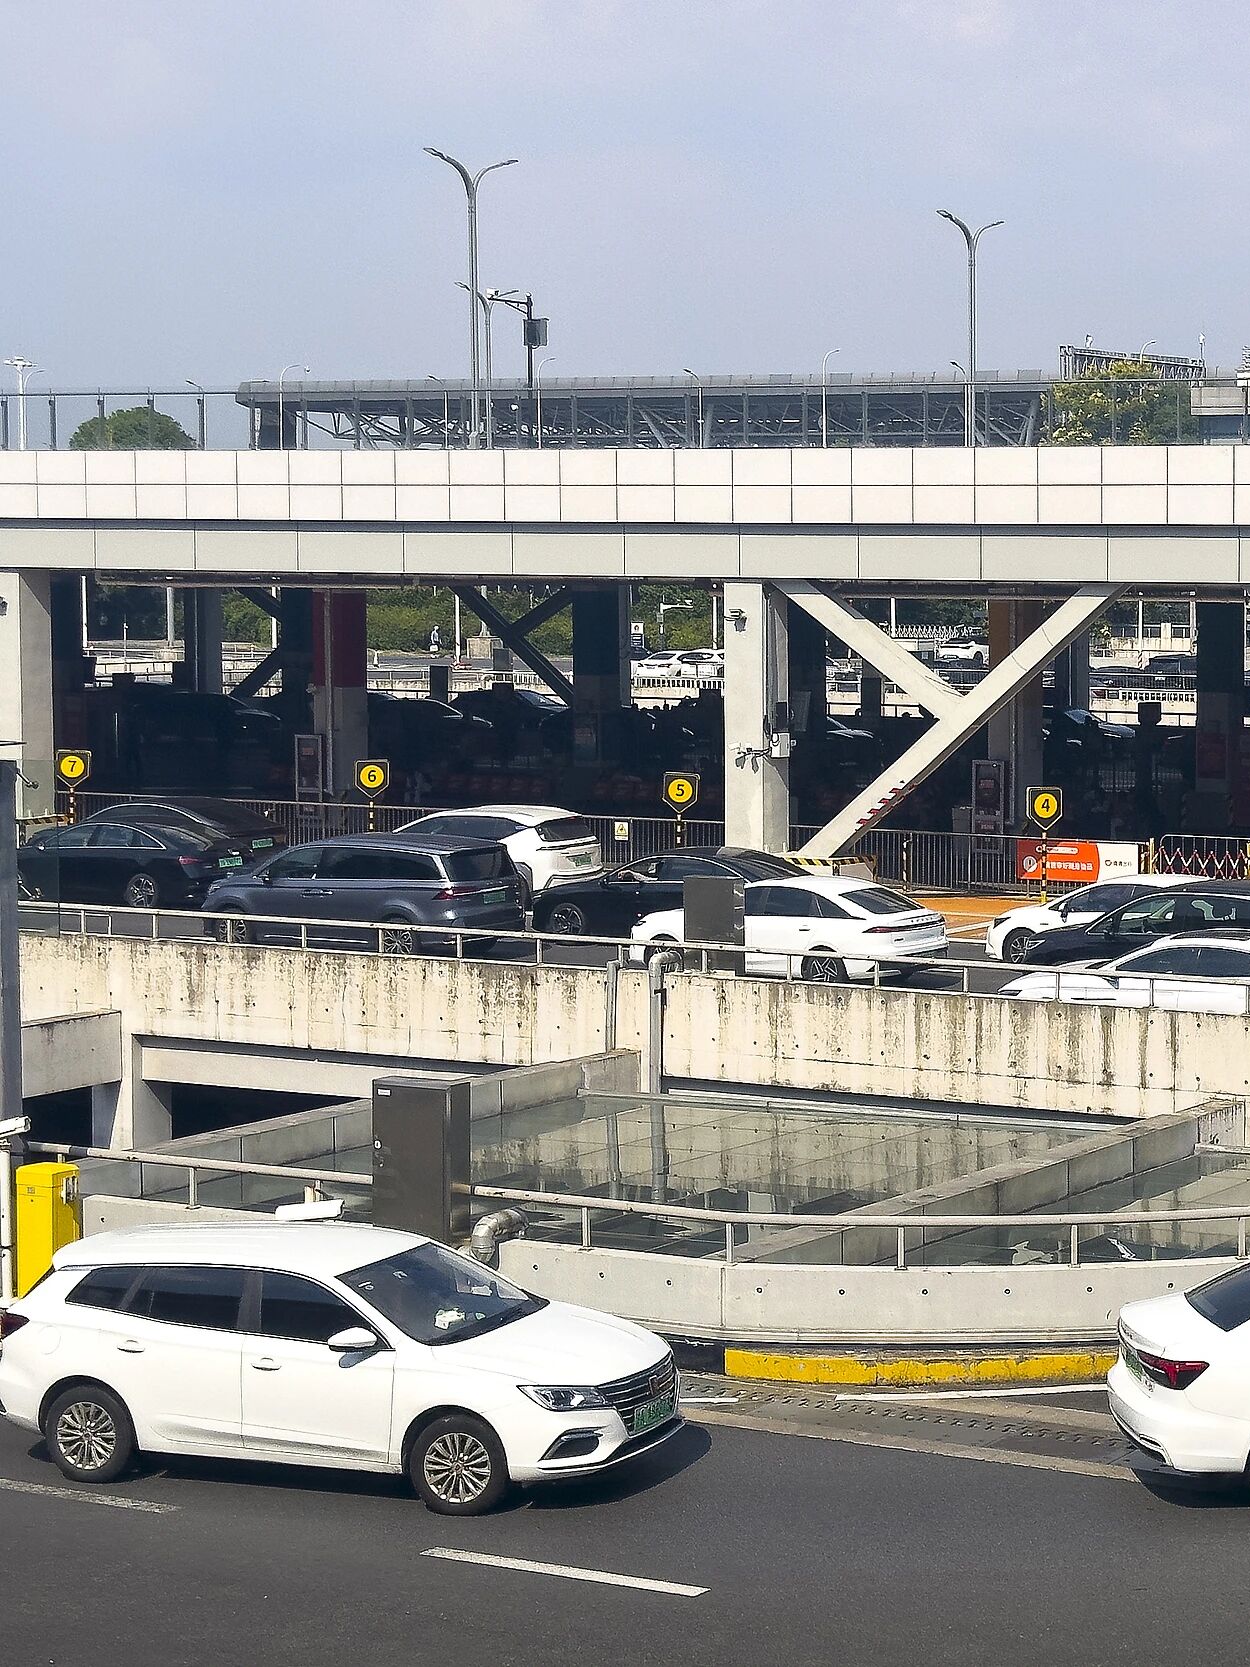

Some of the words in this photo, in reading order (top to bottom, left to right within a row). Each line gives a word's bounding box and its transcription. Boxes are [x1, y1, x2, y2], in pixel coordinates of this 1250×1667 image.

[68, 760, 77, 772] 7
[368, 770, 377, 783] 6
[676, 784, 685, 797] 5
[1041, 799, 1050, 813] 4
